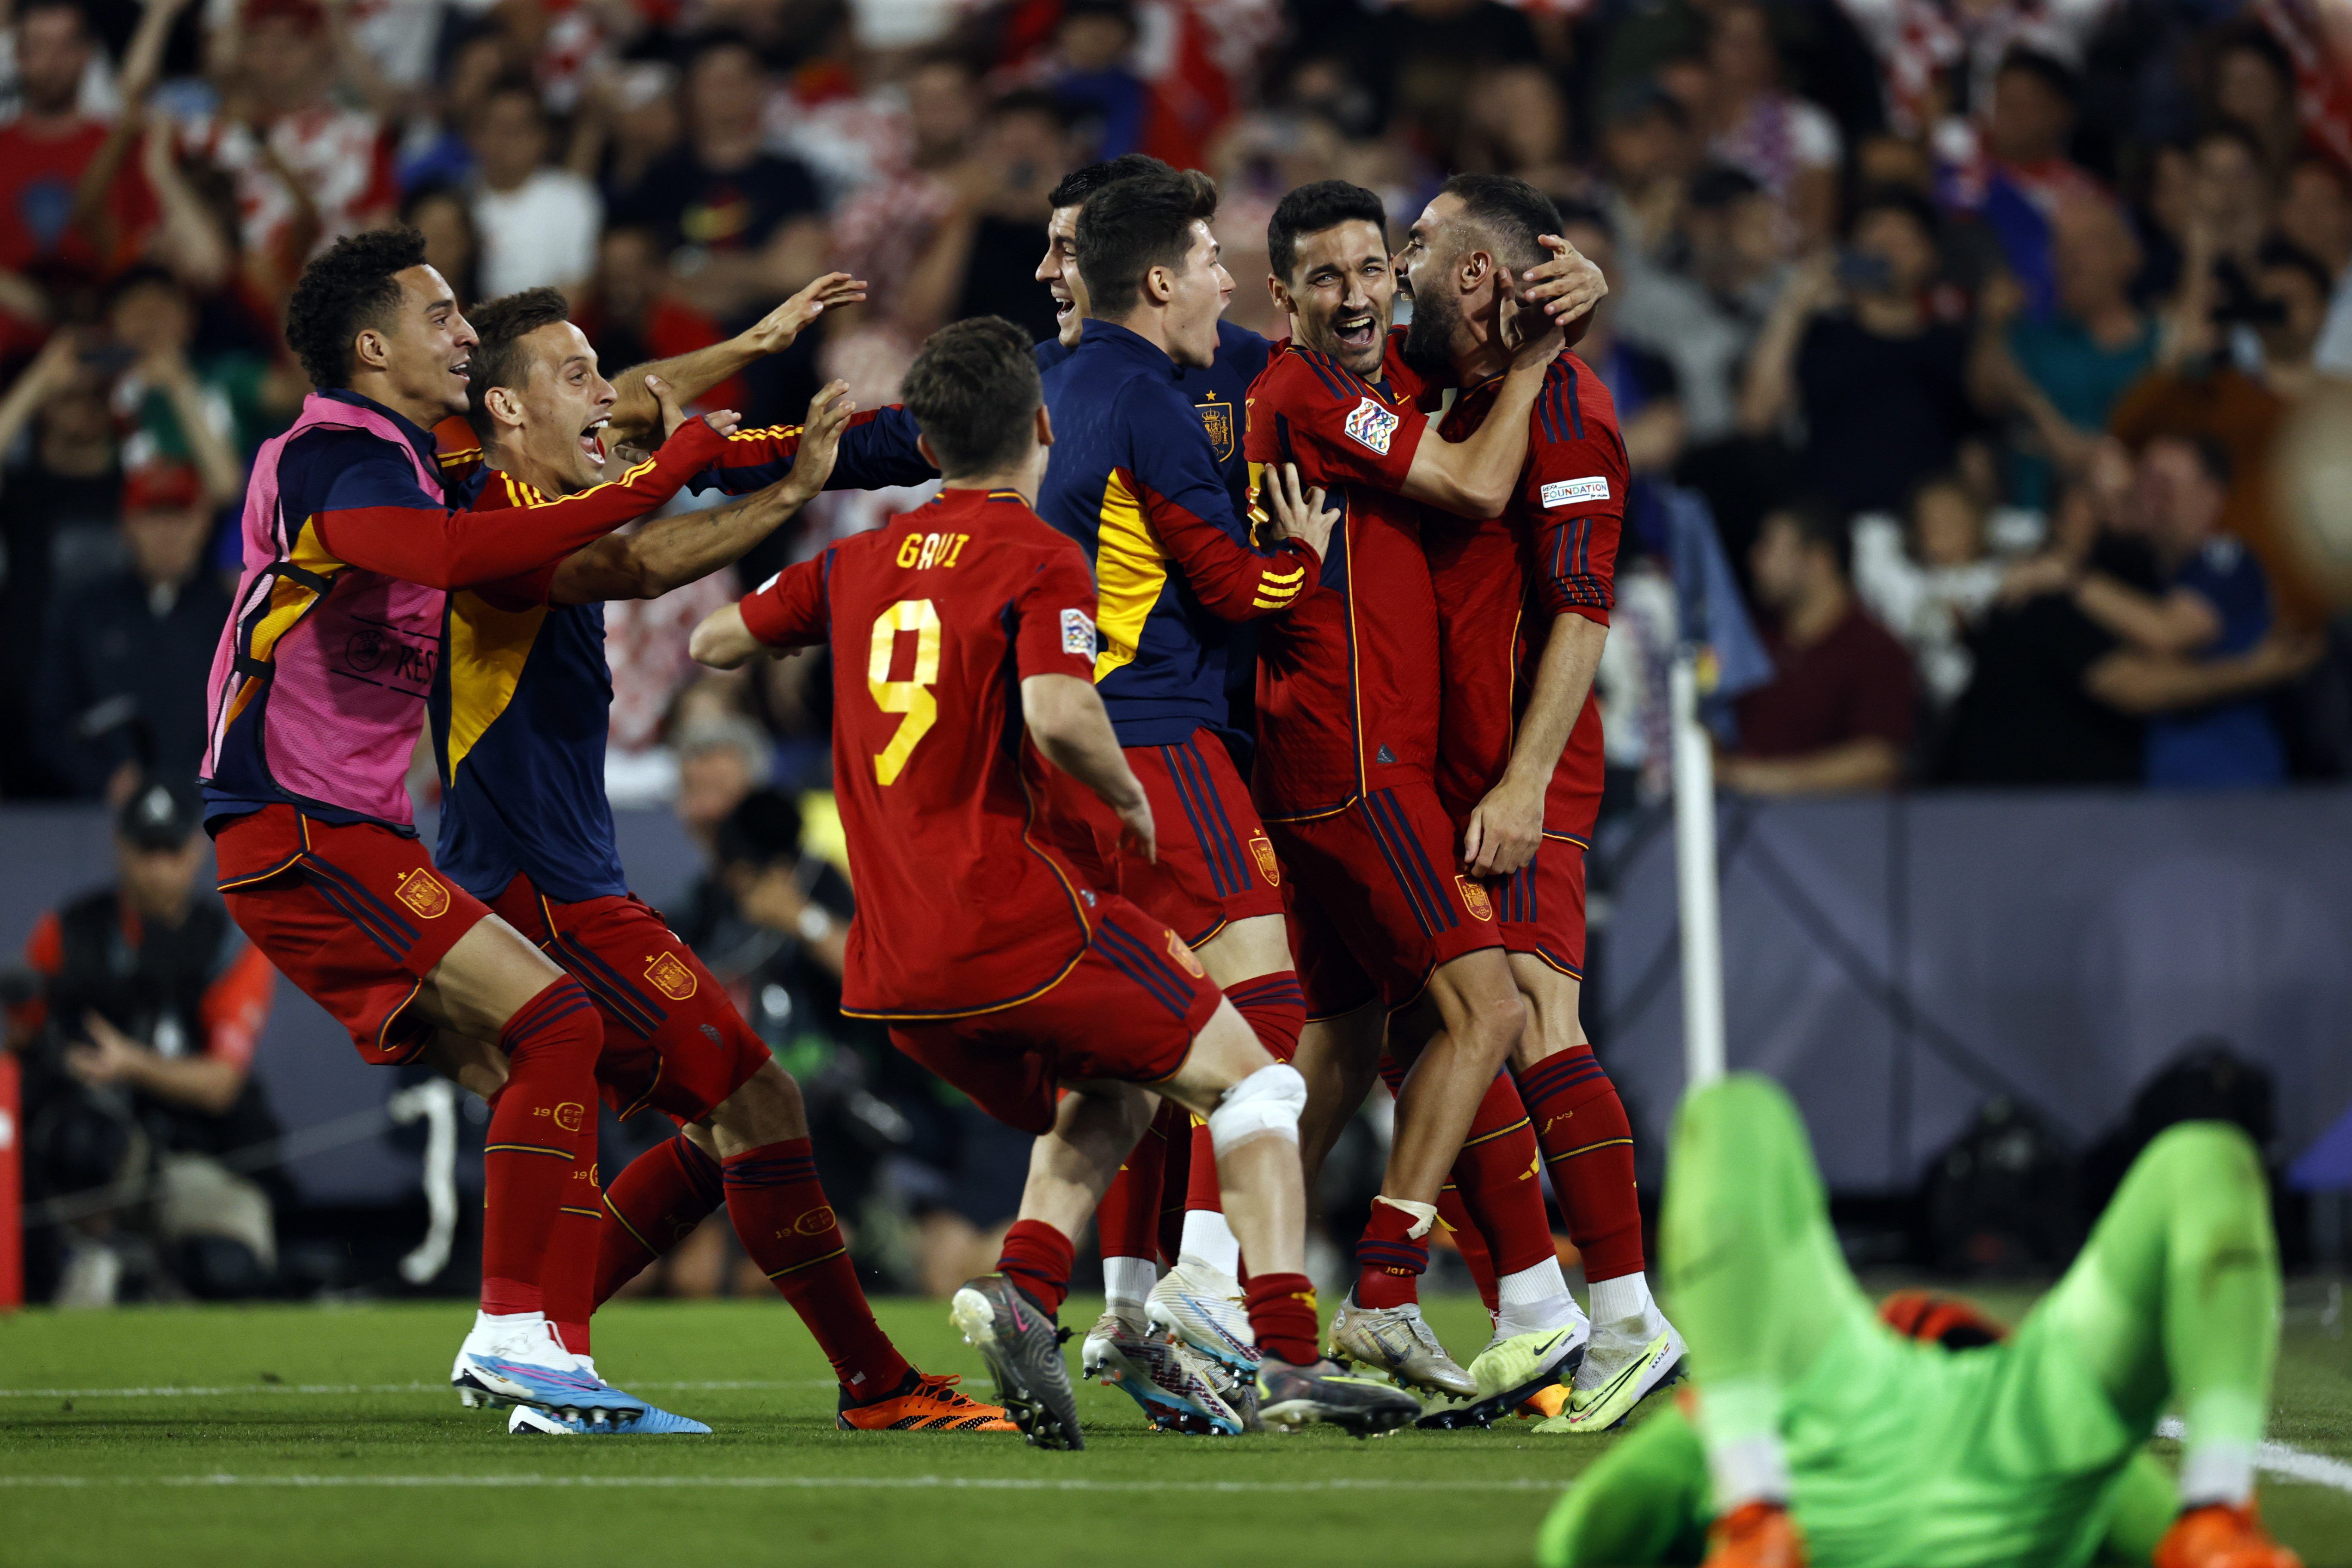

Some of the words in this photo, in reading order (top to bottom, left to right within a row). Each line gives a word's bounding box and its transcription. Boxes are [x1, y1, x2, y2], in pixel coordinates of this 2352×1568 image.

[1543, 484, 1558, 496] UEFA
[896, 533, 970, 570] GAVI
[394, 644, 436, 685] RES
[868, 598, 941, 786] 9
[533, 1107, 551, 1116] 19
[573, 1170, 588, 1179] 19
